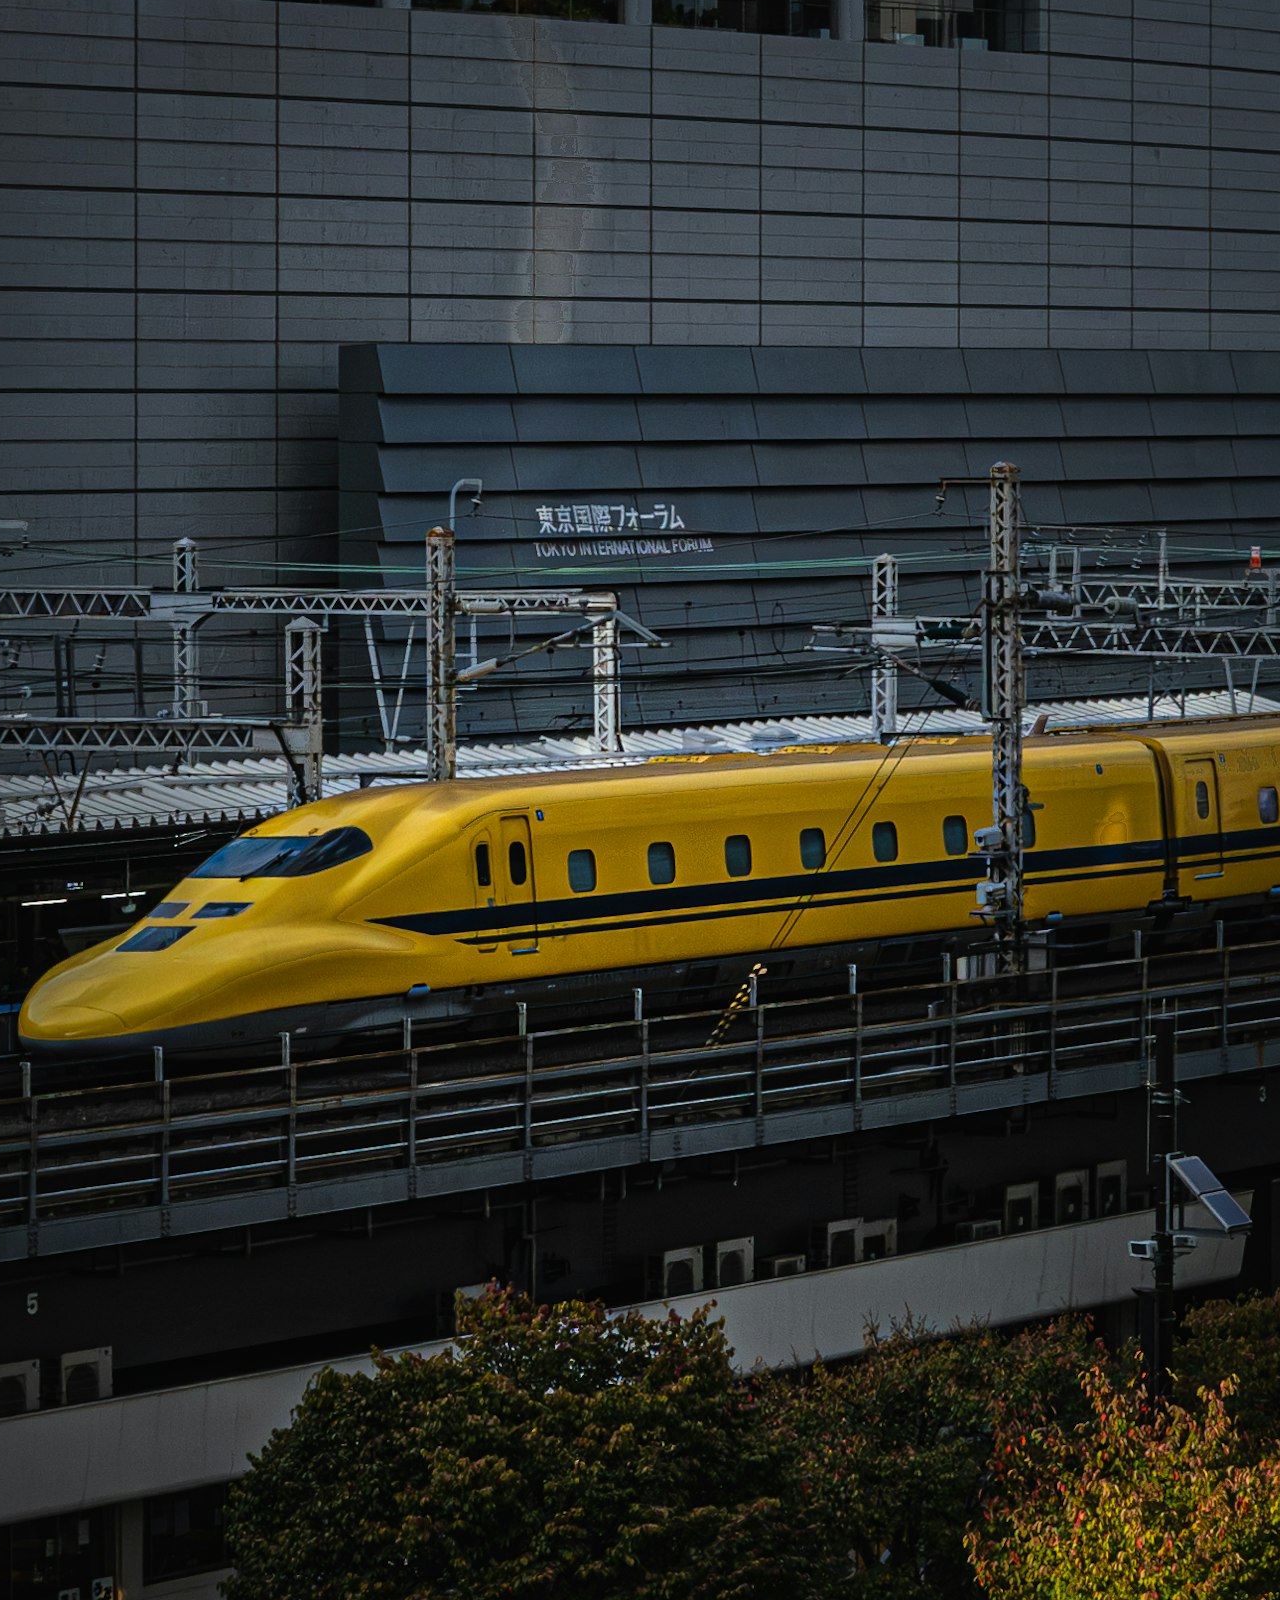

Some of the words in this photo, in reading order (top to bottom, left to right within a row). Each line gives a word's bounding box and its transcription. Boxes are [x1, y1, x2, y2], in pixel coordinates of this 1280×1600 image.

[536, 504, 685, 534] 東京国際フォーラム
[533, 542, 576, 558] TOKYO
[579, 539, 671, 557] INTERNATIONAL
[672, 538, 714, 553] FORUM
[27, 1292, 39, 1315] 5
